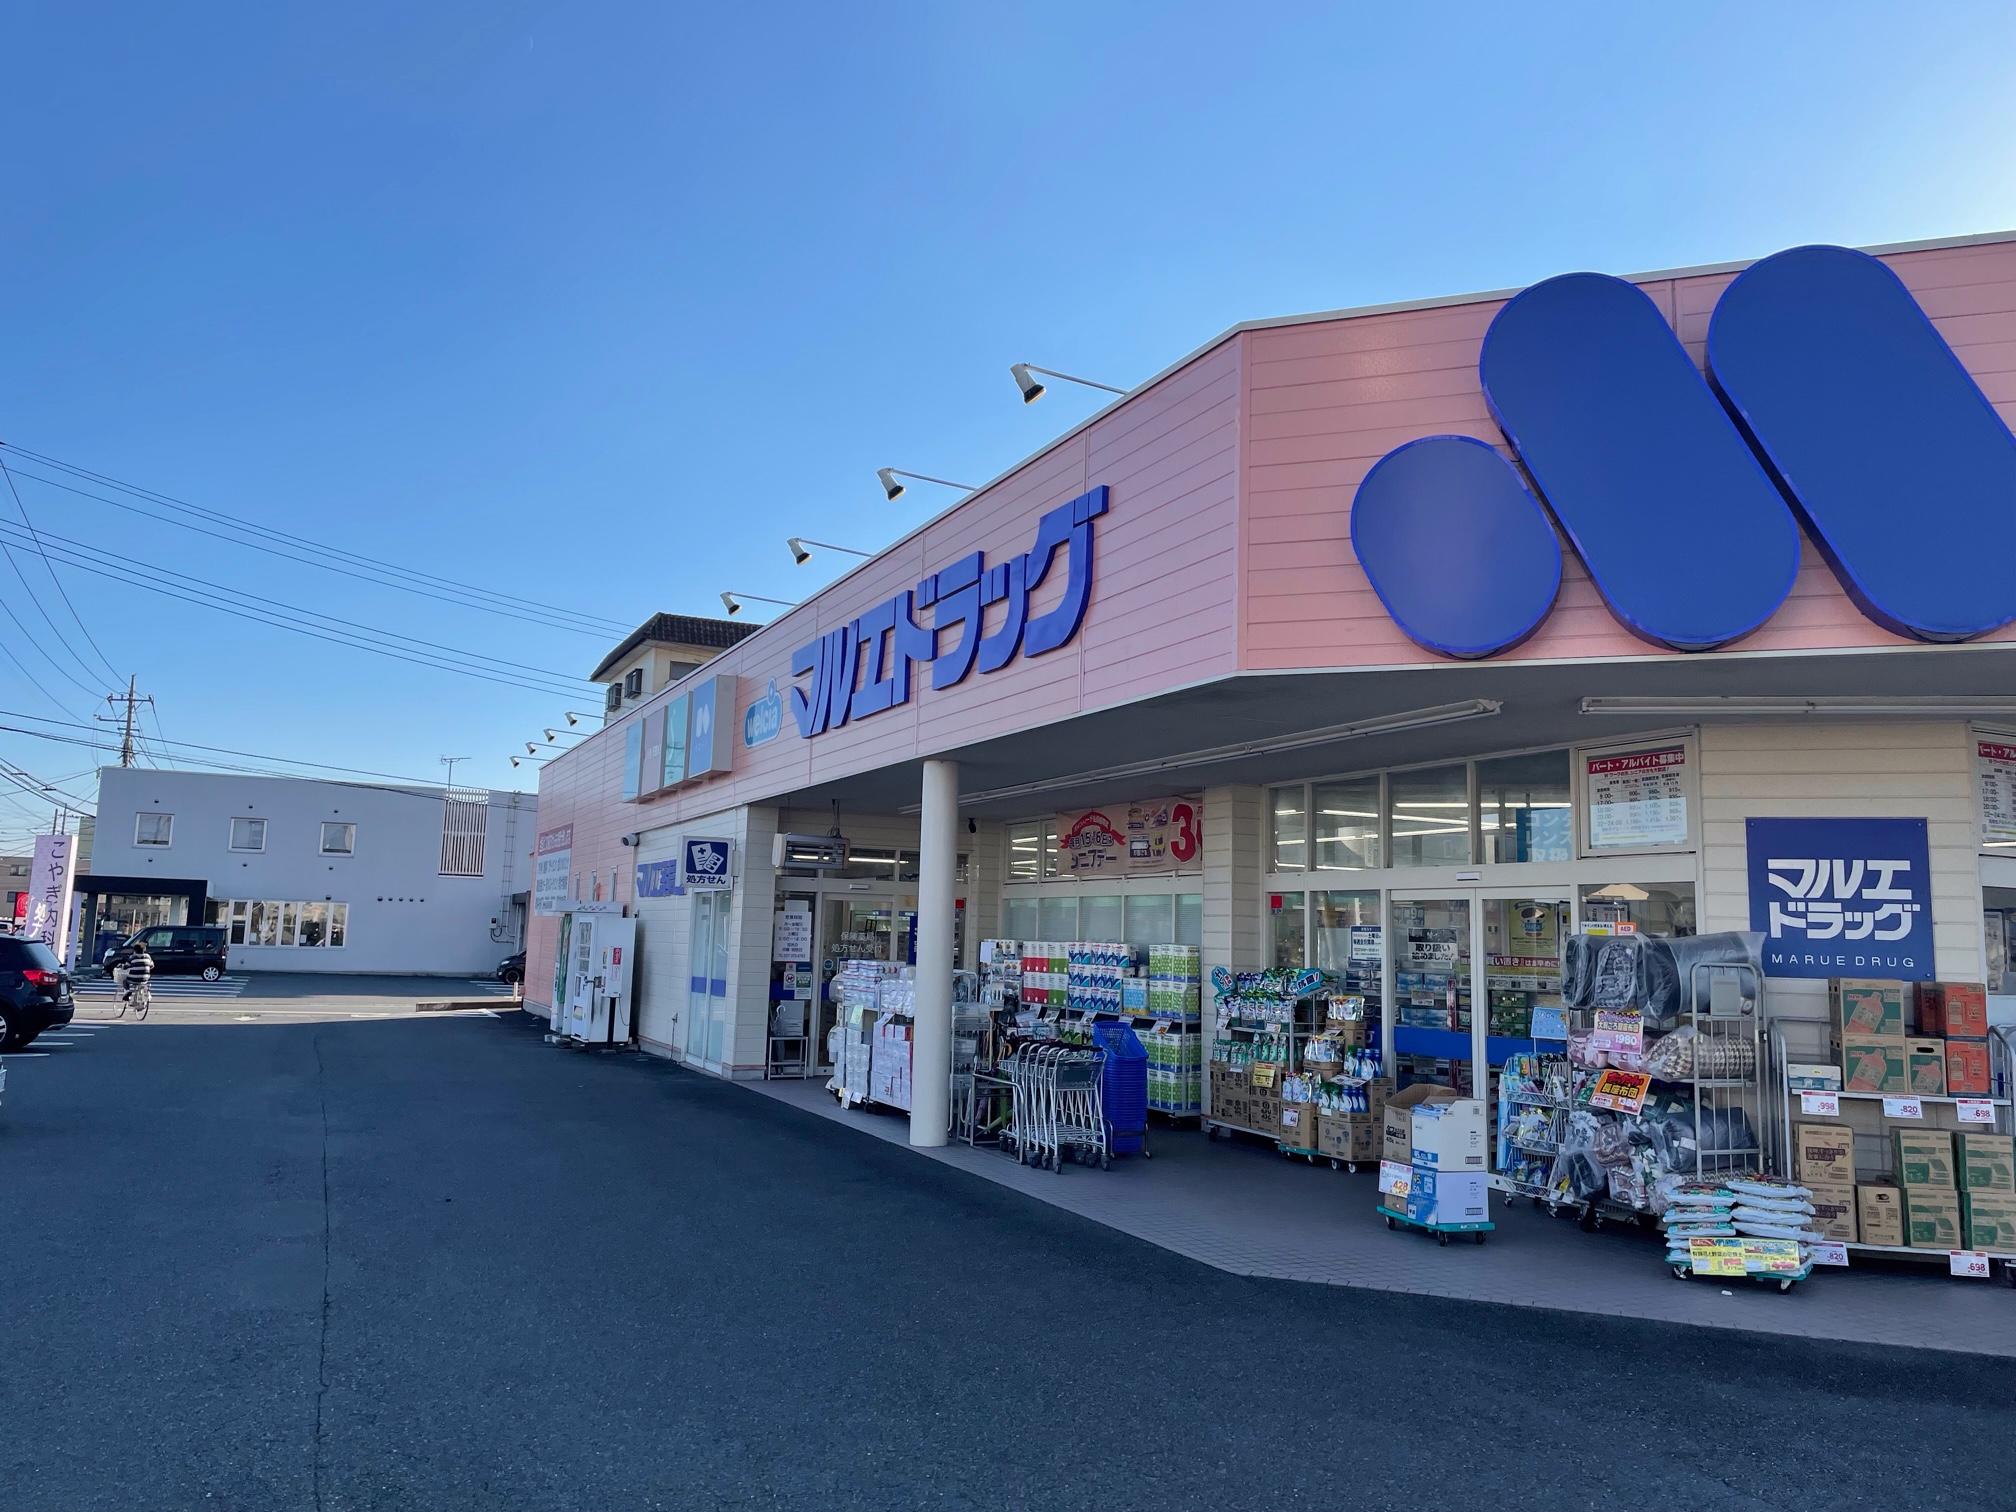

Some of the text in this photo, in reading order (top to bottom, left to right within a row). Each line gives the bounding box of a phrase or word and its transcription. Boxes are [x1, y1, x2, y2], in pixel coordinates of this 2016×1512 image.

[791, 484, 1110, 739] マルエドラッグ
[746, 704, 779, 739] welcia
[1592, 753, 1684, 772] パート・アルバイト募集中
[686, 874, 726, 885] 処方せん
[1767, 859, 1913, 900] マルエ
[1769, 901, 1921, 941] ドラッグ
[831, 944, 882, 954] 処方せん受付
[1771, 954, 1914, 968] MARUE DRUG
[1615, 1034, 1637, 1046] 1980
[1975, 1110, 1990, 1118] 698
[1970, 1263, 1986, 1271] 698
